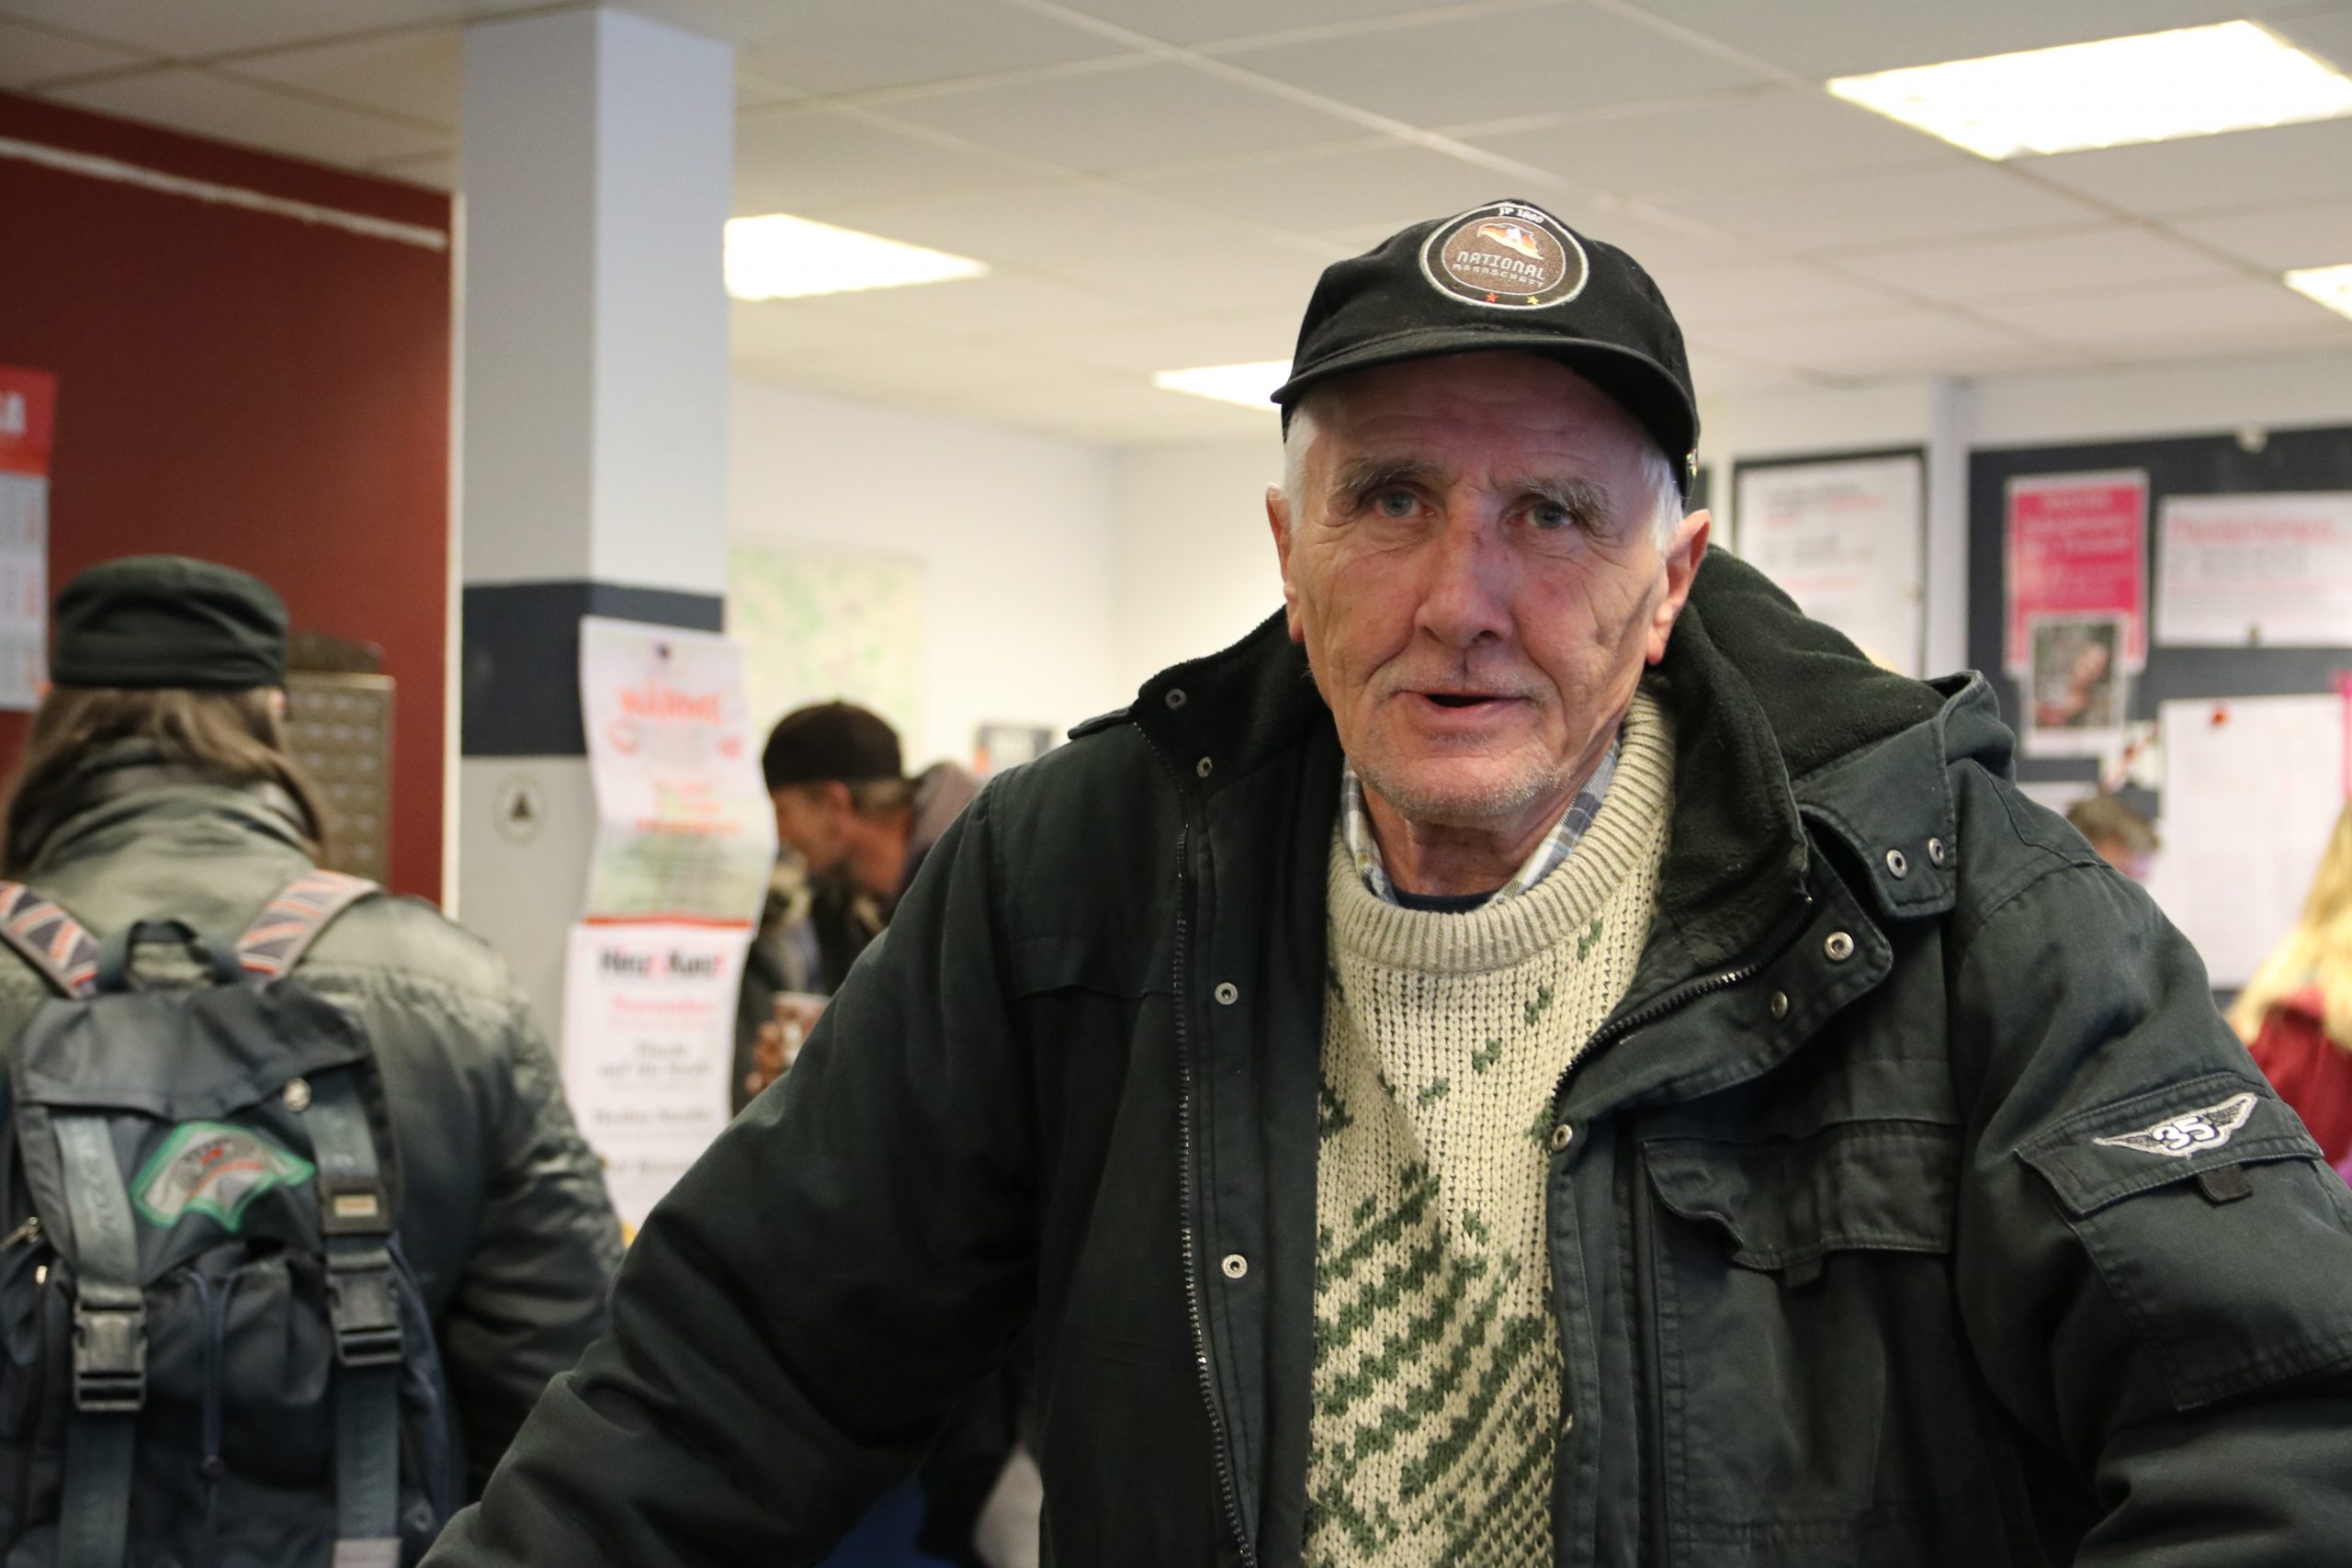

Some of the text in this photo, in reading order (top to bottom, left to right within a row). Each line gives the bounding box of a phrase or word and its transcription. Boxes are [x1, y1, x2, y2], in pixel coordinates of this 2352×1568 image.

[1498, 207, 1515, 217] JP
[1453, 263, 1544, 288] MANNSCHAFT
[1457, 251, 1545, 280] NATIONAL
[2152, 1116, 2218, 1150] 35
